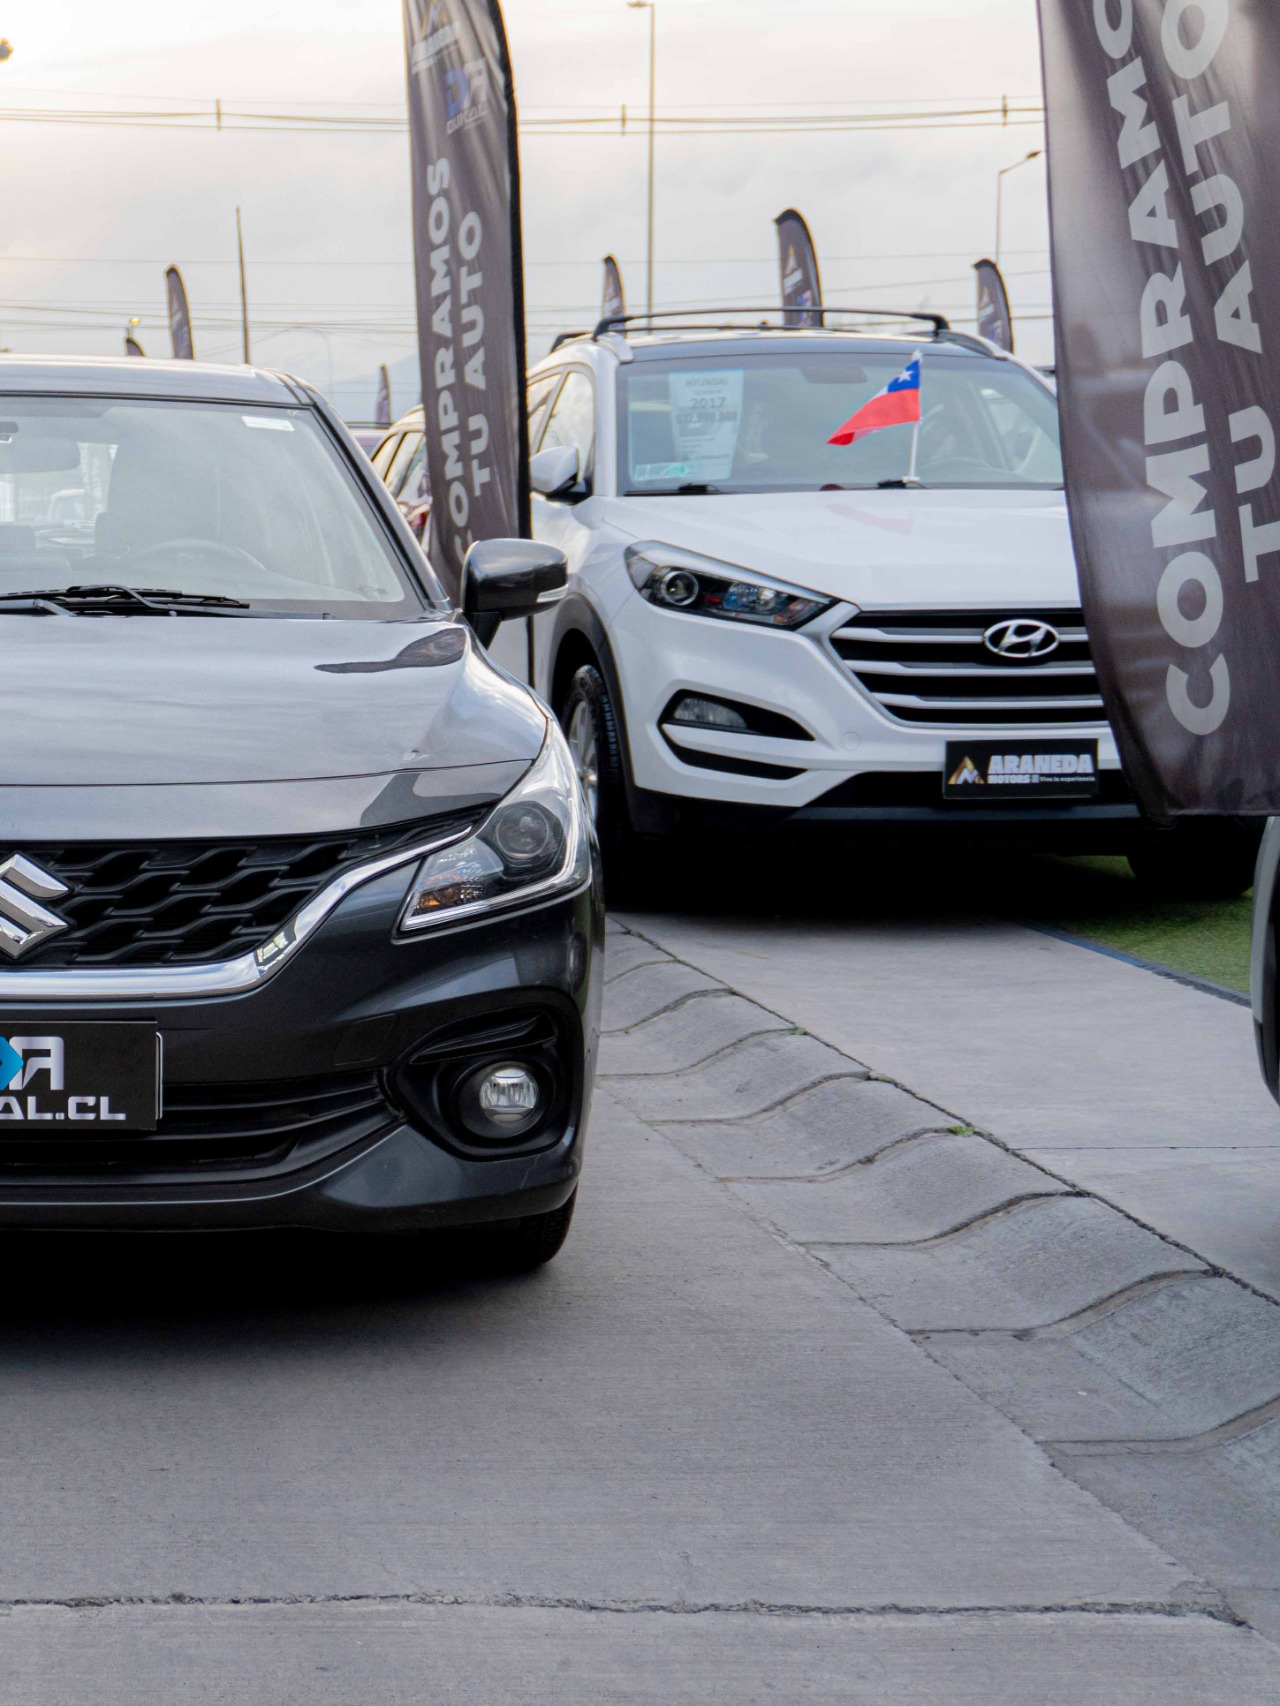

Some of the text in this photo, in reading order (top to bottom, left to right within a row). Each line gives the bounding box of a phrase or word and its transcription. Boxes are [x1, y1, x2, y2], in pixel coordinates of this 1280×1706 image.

[458, 210, 491, 497] TU AUTO
[1161, 0, 1280, 584] TU AUTO
[690, 397, 726, 409] 2017
[987, 754, 1094, 774] ARANEDA
